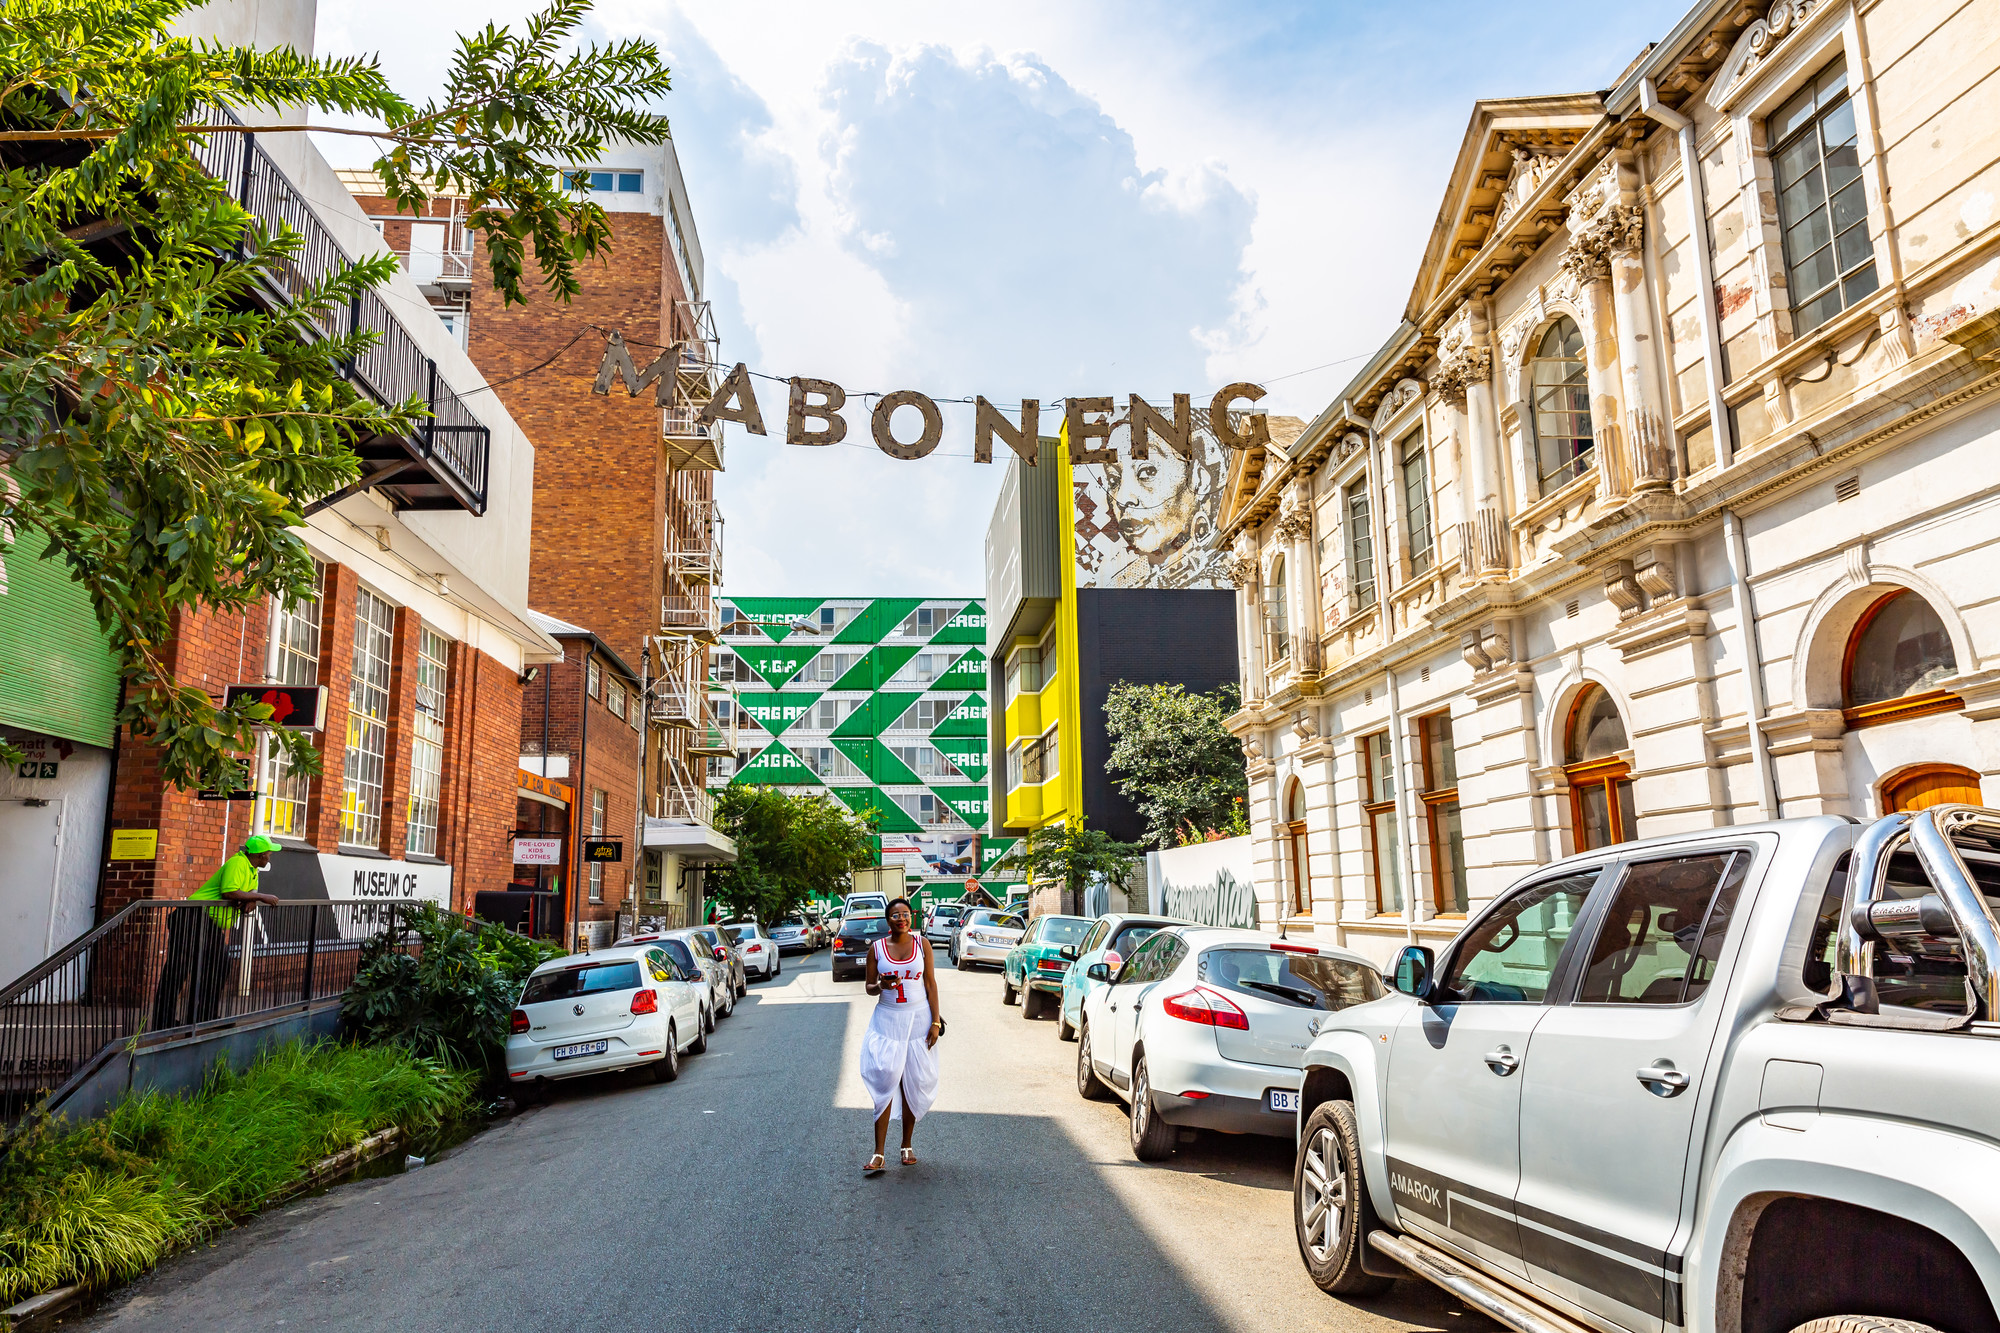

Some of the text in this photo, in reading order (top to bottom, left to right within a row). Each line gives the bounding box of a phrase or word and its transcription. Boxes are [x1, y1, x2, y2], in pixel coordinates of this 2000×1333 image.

[592, 328, 1270, 466] MABONENG
[352, 870, 418, 897] MUSEUM OF
[895, 983, 908, 1004] 1
[556, 1047, 566, 1057] FH
[568, 1045, 578, 1054] 89
[580, 1044, 590, 1053] FR
[595, 1041, 606, 1051] GP
[1273, 1093, 1288, 1108] BB
[1390, 1171, 1442, 1209] AMAROK
